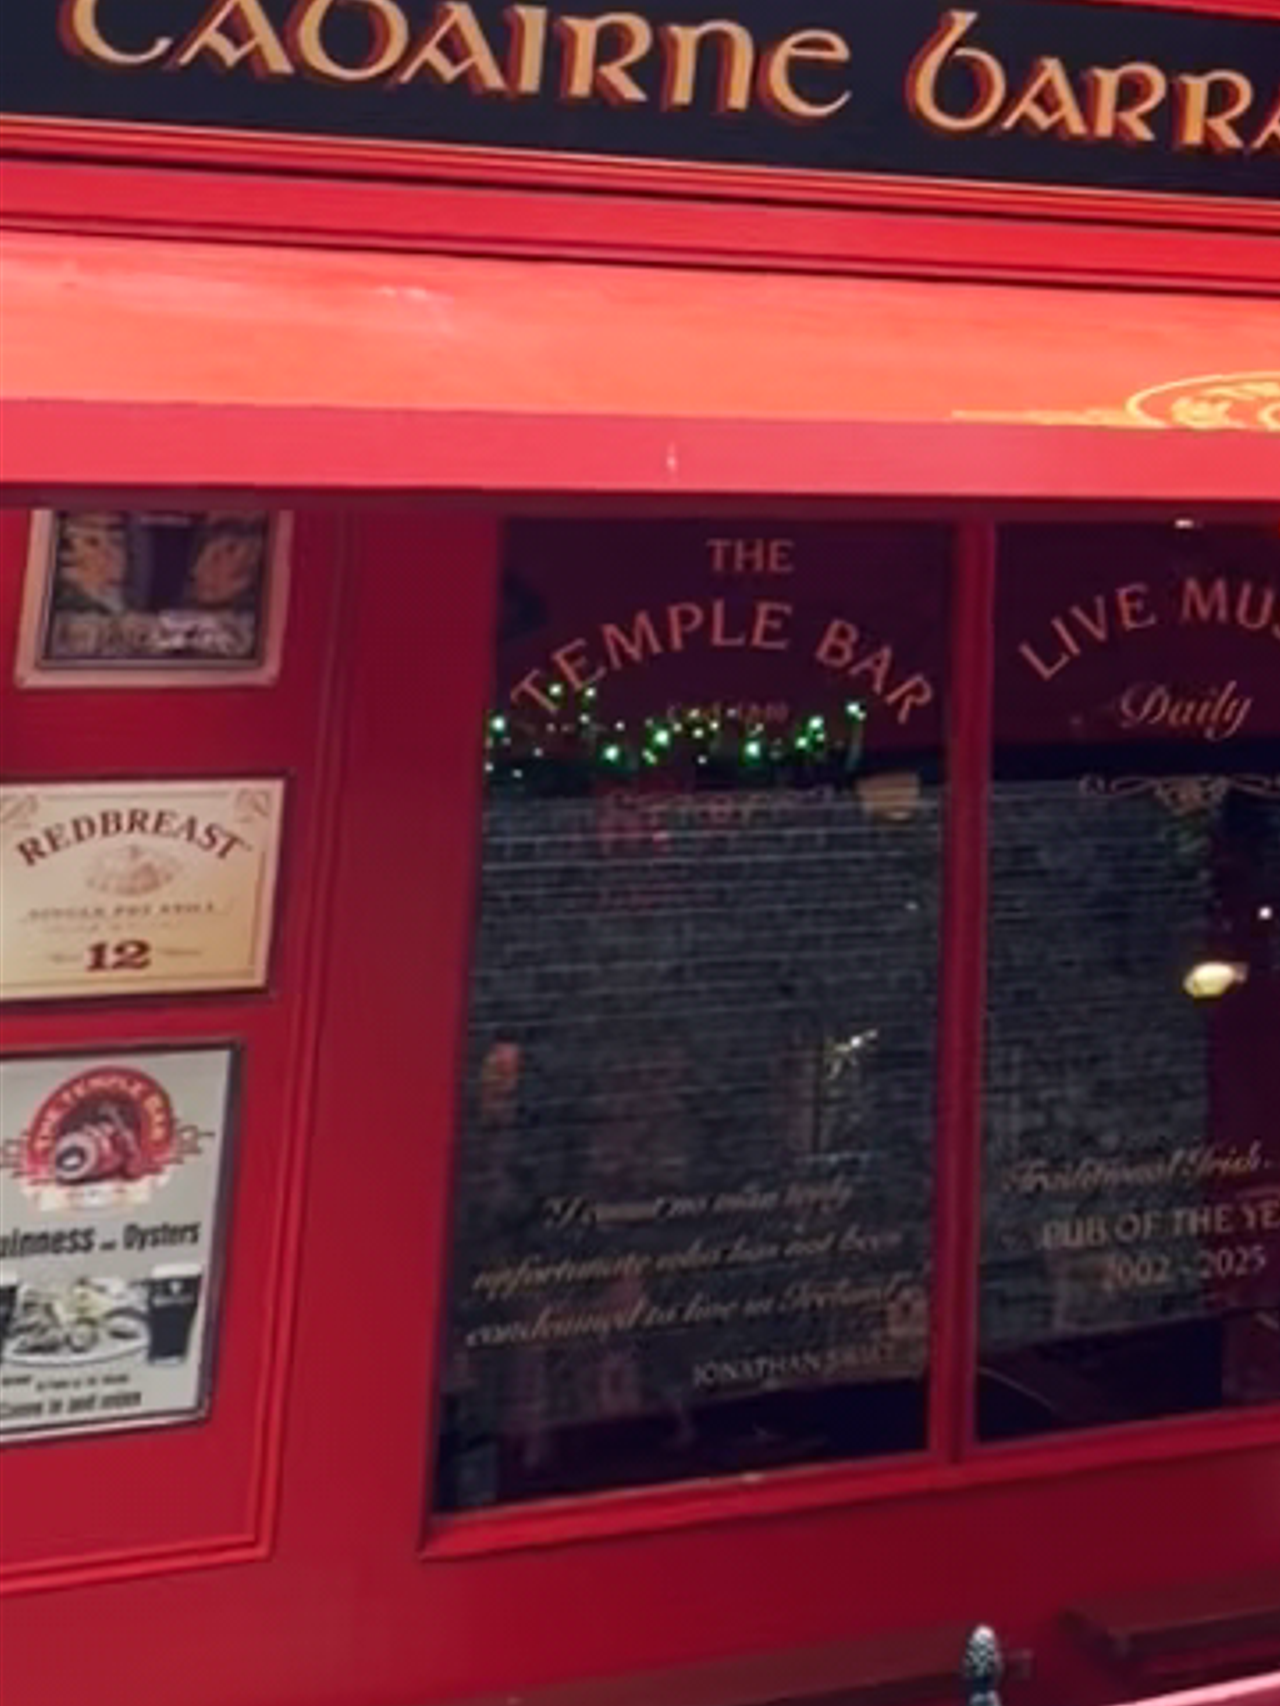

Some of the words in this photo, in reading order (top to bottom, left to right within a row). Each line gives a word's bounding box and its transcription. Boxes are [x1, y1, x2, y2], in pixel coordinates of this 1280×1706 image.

[705, 538, 796, 572] THE
[1018, 583, 1157, 681] LIVE
[510, 598, 793, 716] TEMPLE
[814, 618, 933, 724] BAR
[1119, 680, 1253, 740] Daily
[16, 807, 246, 867] REDBREAST
[85, 940, 152, 972] 12
[123, 1222, 201, 1249] Oysters
[1041, 1219, 1108, 1250] PUB
[1114, 1212, 1162, 1242] OF
[1170, 1201, 1236, 1237] THE
[692, 1349, 821, 1387] JONATHAN
